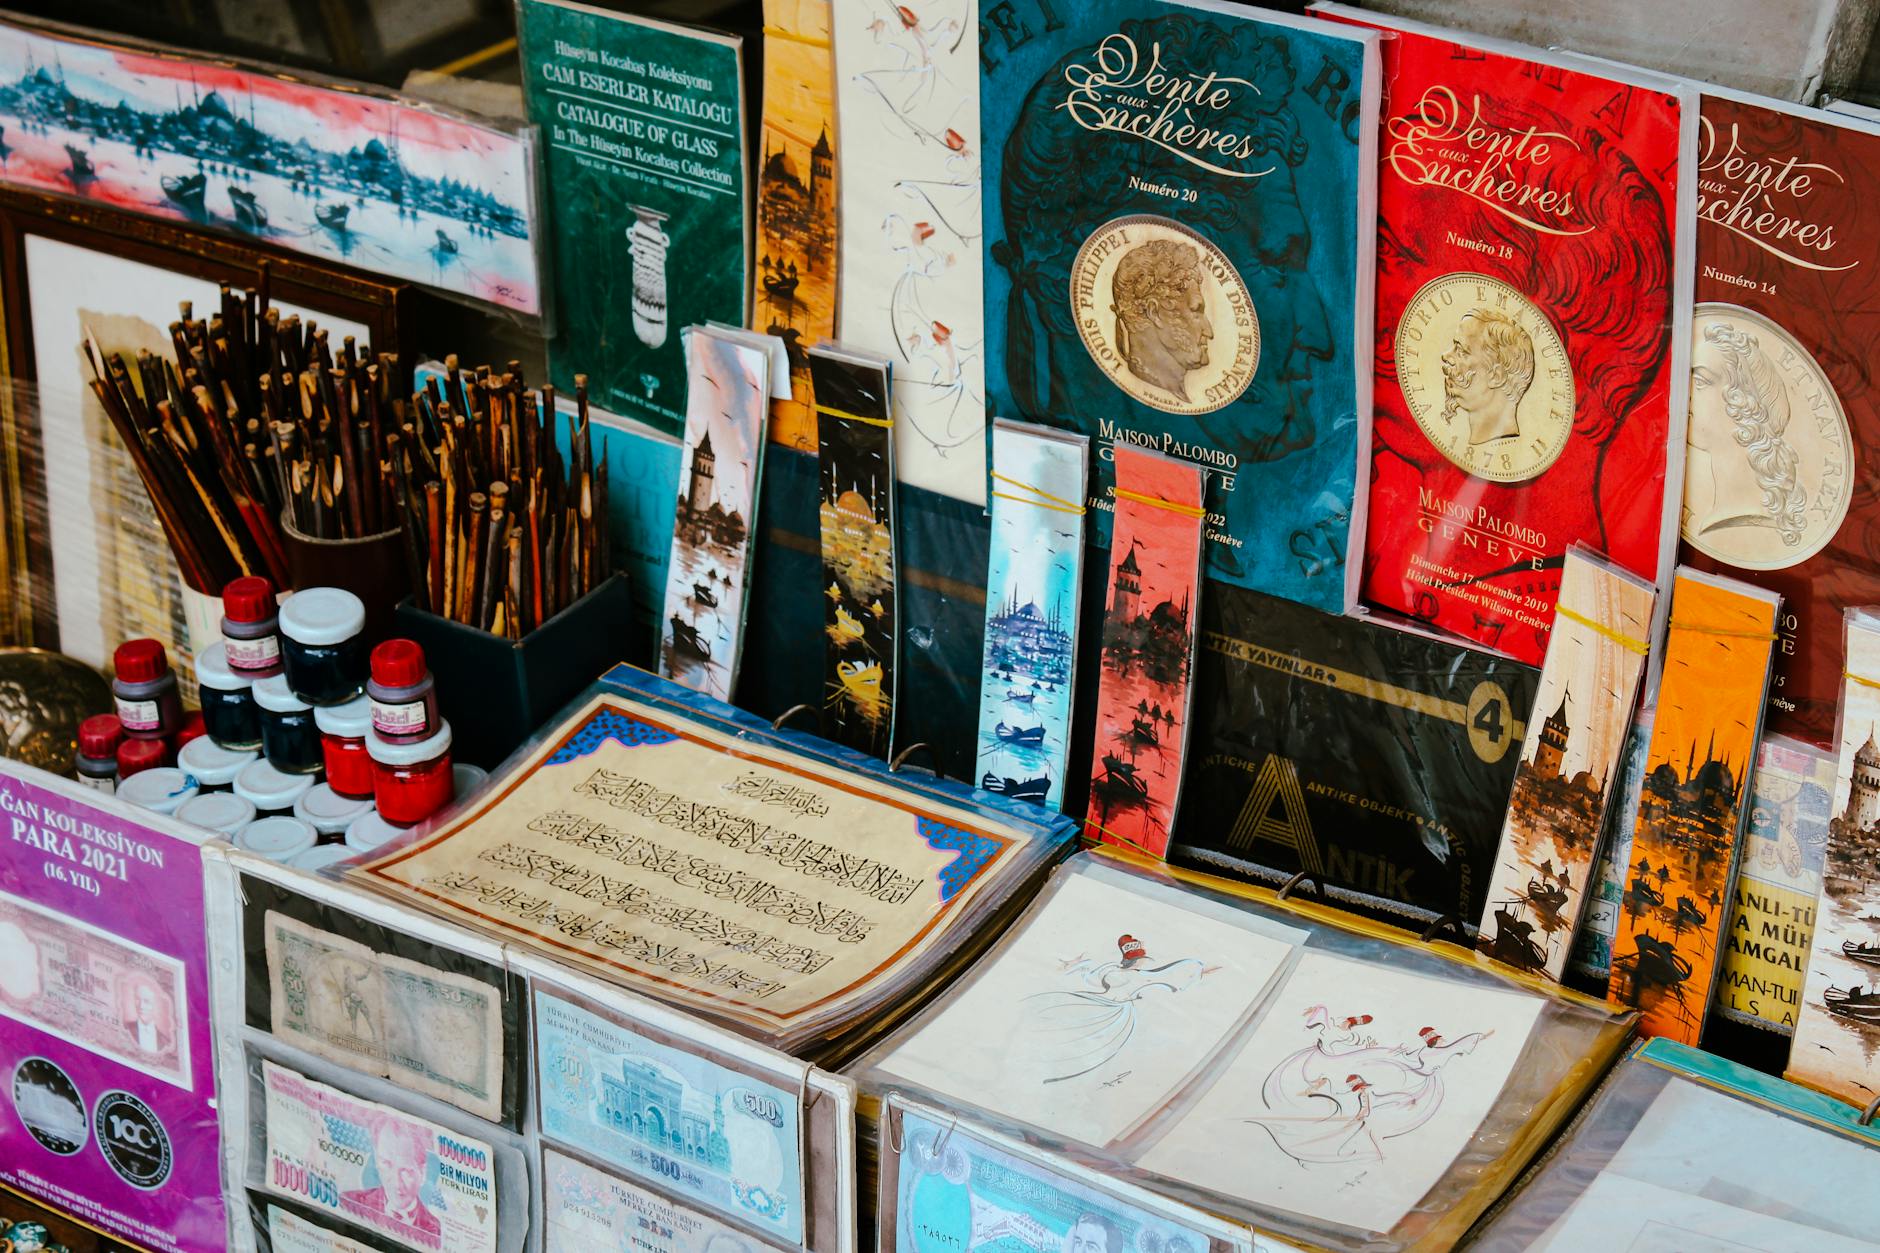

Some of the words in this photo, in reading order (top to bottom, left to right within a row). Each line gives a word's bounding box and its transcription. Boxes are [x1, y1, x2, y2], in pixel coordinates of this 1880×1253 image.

[554, 39, 598, 62] Hüseyin
[600, 50, 645, 76] Kocabaş
[648, 62, 713, 92] Koleksiyonu
[1093, 33, 1261, 111] Vente
[543, 63, 575, 86] CAM
[579, 71, 649, 104] ESERLER
[652, 89, 732, 125] KATALOĞU
[1116, 93, 1149, 110] aux
[557, 101, 644, 139] CATALOGUE
[647, 124, 668, 144] OF
[672, 130, 718, 158] GLASS
[1055, 64, 1277, 178] Enchères
[1413, 85, 1581, 165] Vente
[553, 125, 565, 140] In
[567, 129, 588, 147] The
[590, 135, 632, 159] Hüseyin
[635, 145, 680, 173] Kocabaş
[681, 159, 733, 186] Collection
[1380, 117, 1597, 236] Enchères
[1438, 146, 1470, 164] aux
[1128, 175, 1179, 201] Numéro
[1181, 187, 1198, 203] 20
[1080, 233, 1119, 310] PHILIPPE
[1201, 252, 1231, 287] ROI
[1446, 231, 1496, 256] Numéro
[1498, 244, 1514, 260] 18
[1702, 266, 1757, 290] Numéro
[1760, 281, 1777, 296] 14
[1226, 291, 1250, 328] DES
[1084, 317, 1124, 373] LOUIS
[1204, 332, 1253, 404] FRANÇAIS
[1405, 289, 1453, 419] VITTORIO
[1475, 286, 1567, 423] EMANUELE
[1449, 435, 1512, 471] 1878
[1205, 528, 1244, 549] Genève
[1406, 567, 1433, 587] Hôtel
[1434, 578, 1479, 604] Président
[1481, 596, 1513, 618] Wilson
[1514, 609, 1552, 633] Genève
[1410, 553, 1460, 581] Dimanche
[1462, 572, 1475, 585] 17
[1476, 579, 1523, 605] novembre
[1523, 595, 1549, 614] 2019
[1473, 698, 1505, 744] 4
[11, 817, 77, 862] PARA
[81, 843, 128, 882] 2021
[43, 807, 164, 868] KOLEKSİYON
[44, 862, 68, 883] (16.
[69, 870, 100, 896] YIL)
[744, 1090, 777, 1121] 500
[438, 1135, 487, 1172] 1000000
[650, 1151, 681, 1181] 500
[272, 1157, 339, 1208] 1000000
